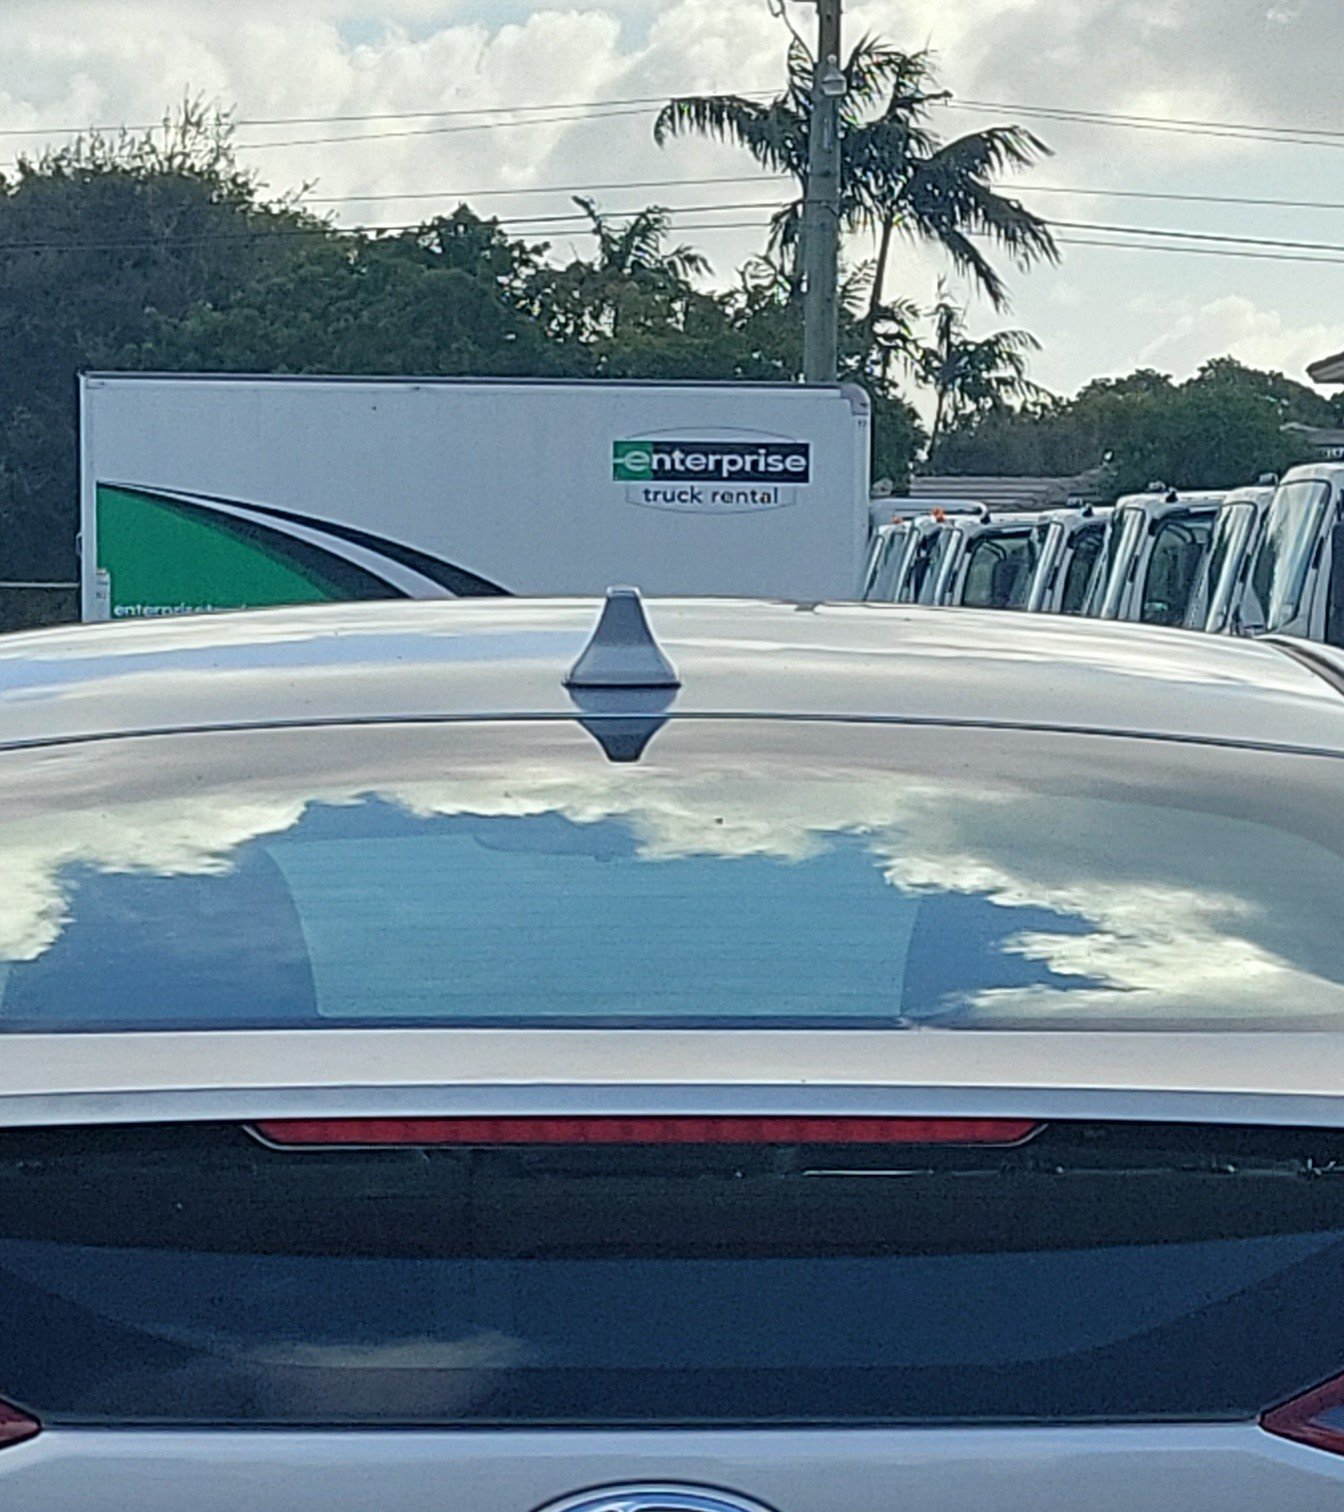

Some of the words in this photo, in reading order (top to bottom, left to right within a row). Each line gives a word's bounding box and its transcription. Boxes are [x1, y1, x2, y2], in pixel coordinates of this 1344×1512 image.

[622, 448, 807, 478] enterprise
[642, 486, 703, 504] truck
[711, 487, 779, 504] rental
